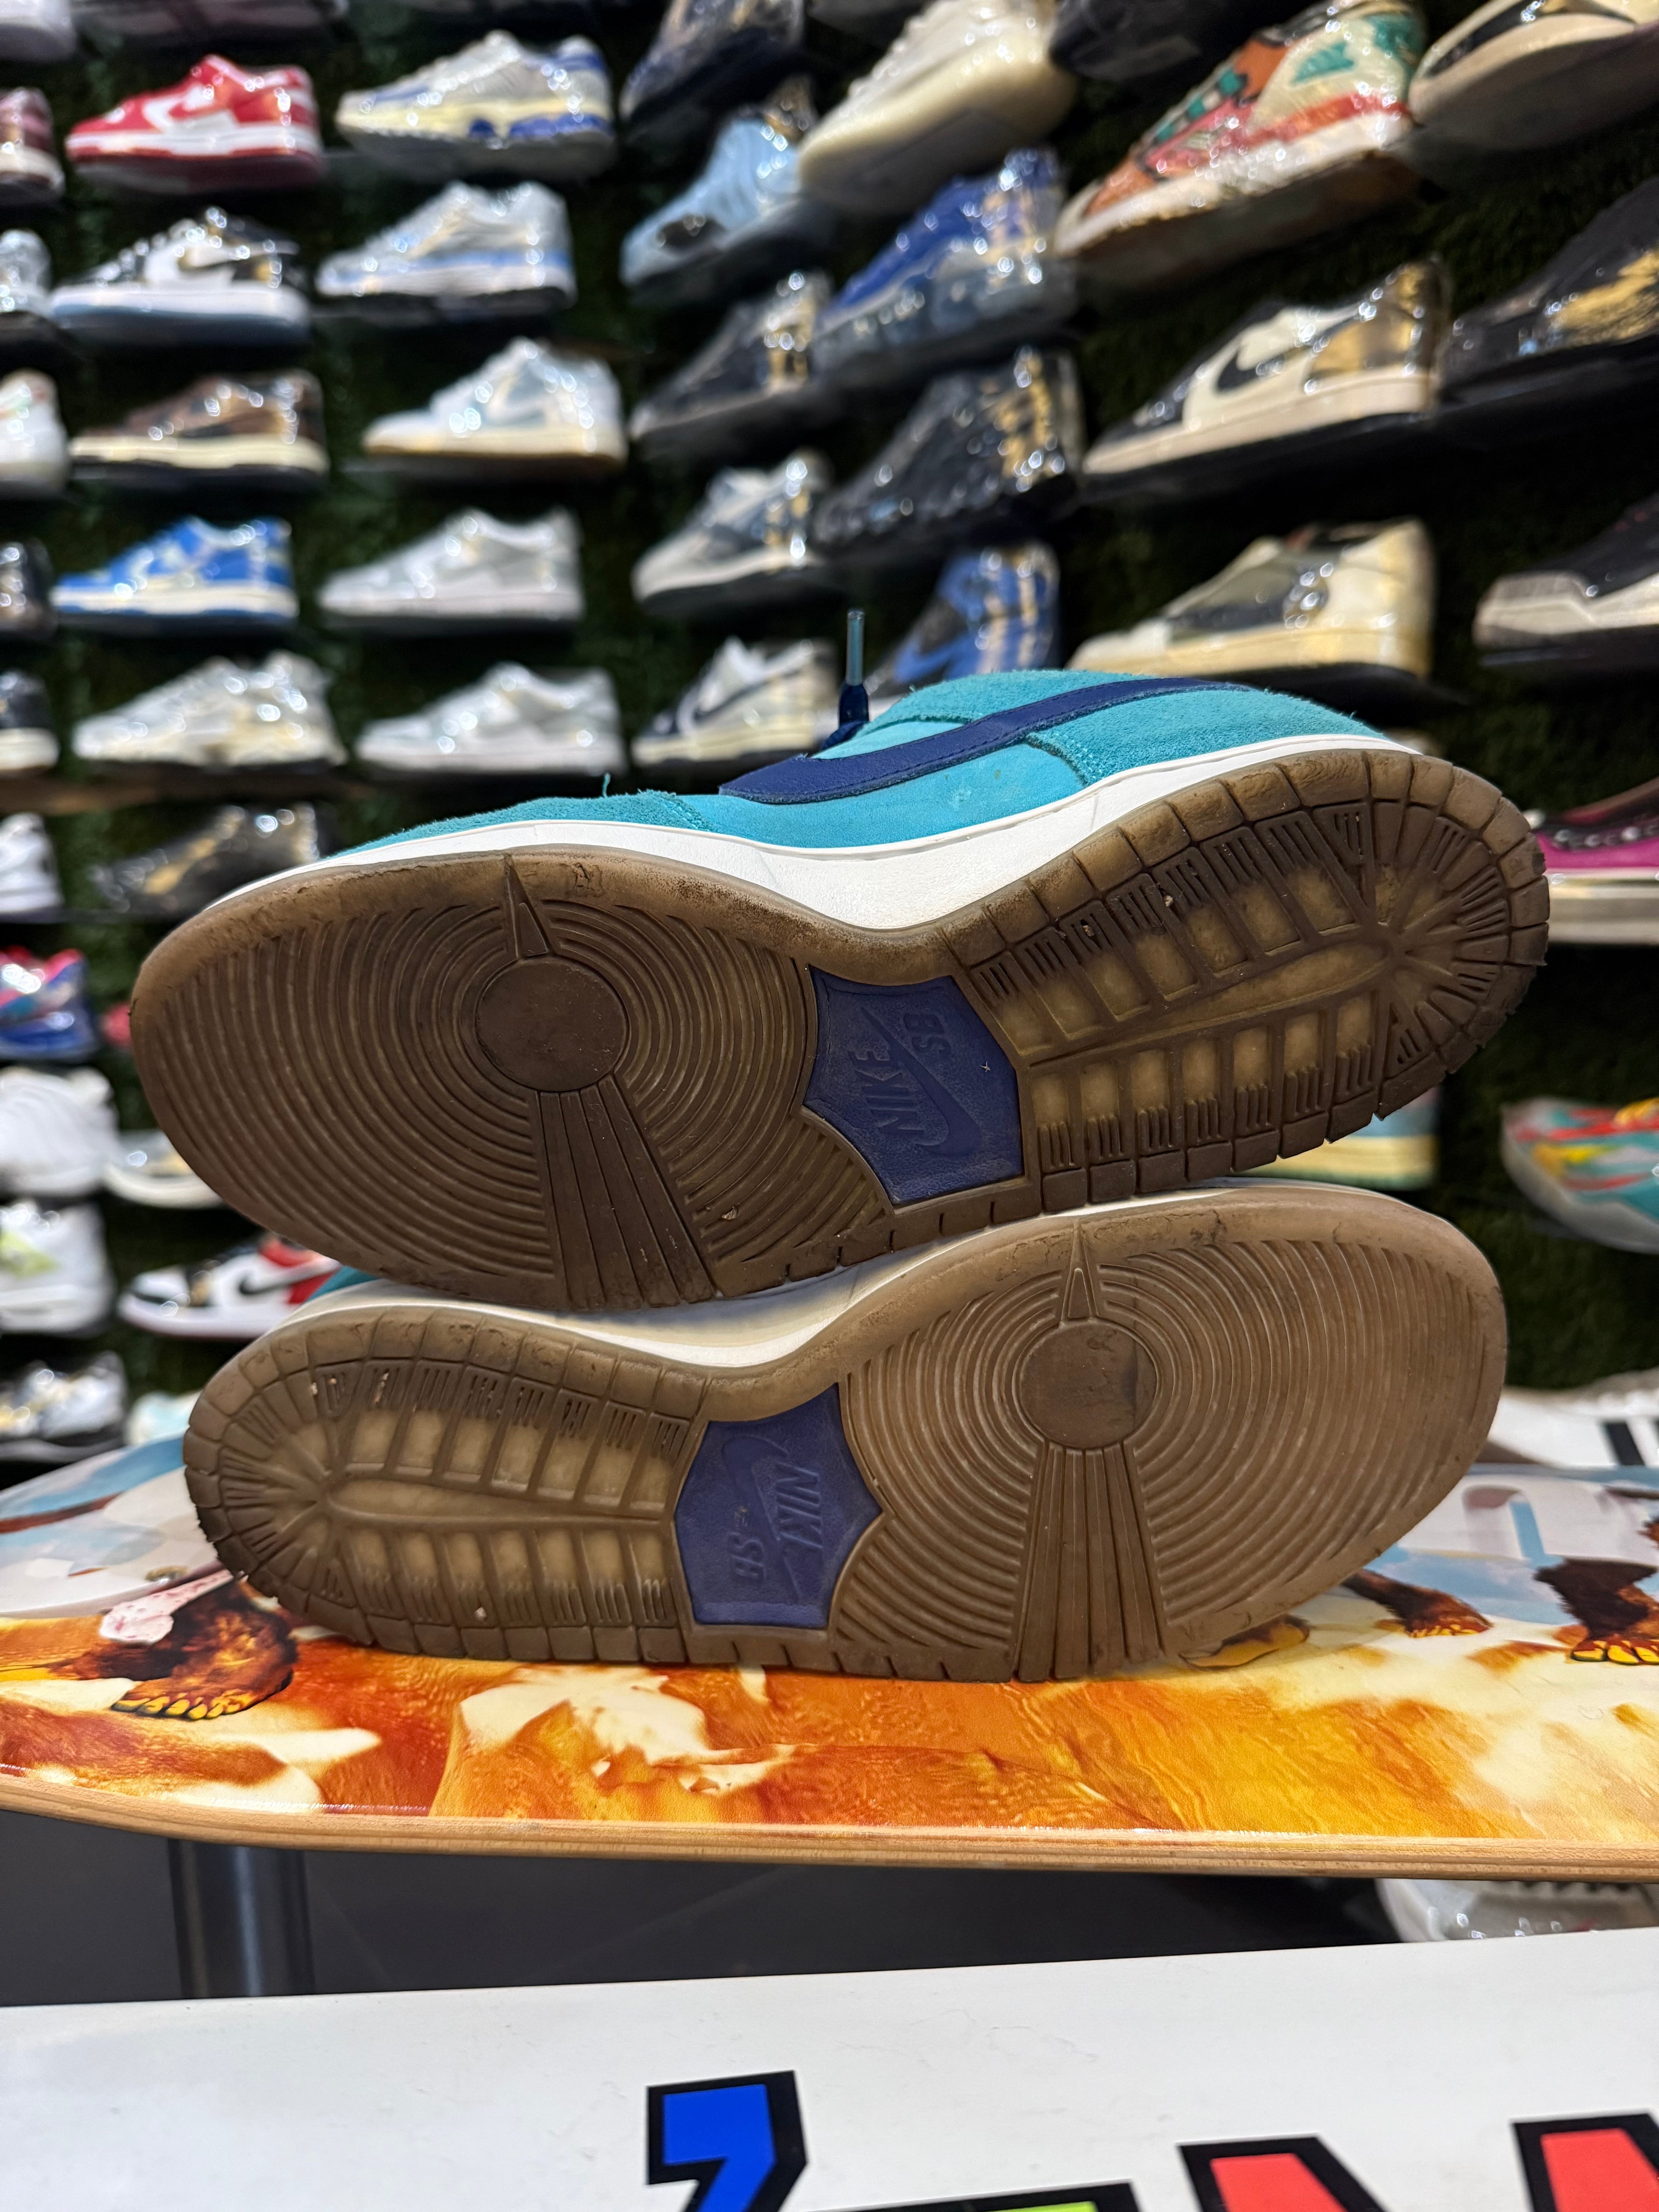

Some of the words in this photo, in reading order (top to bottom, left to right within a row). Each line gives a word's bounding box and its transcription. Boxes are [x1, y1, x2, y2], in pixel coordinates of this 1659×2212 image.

[903, 1012, 951, 1057] SB
[848, 1049, 924, 1135] NIKE
[730, 1530, 767, 1583] SB
